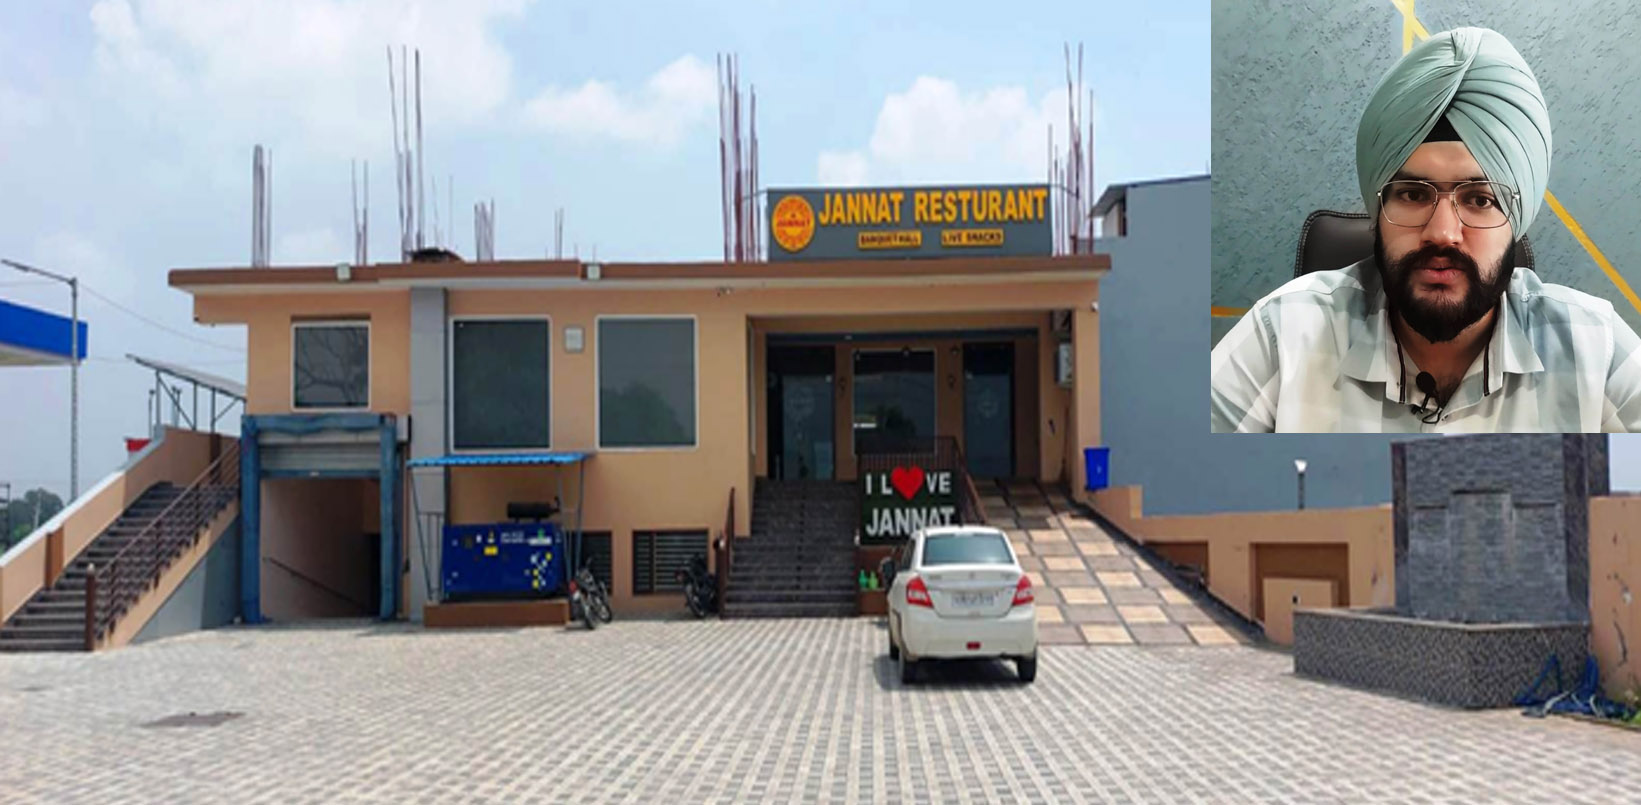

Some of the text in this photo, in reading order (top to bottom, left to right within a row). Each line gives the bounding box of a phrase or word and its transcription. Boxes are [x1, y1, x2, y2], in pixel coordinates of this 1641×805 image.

[819, 188, 1048, 225] JANNAT RESTURANT
[943, 232, 963, 243] LIVE
[866, 473, 872, 495] I
[866, 506, 955, 537] JANNAT
